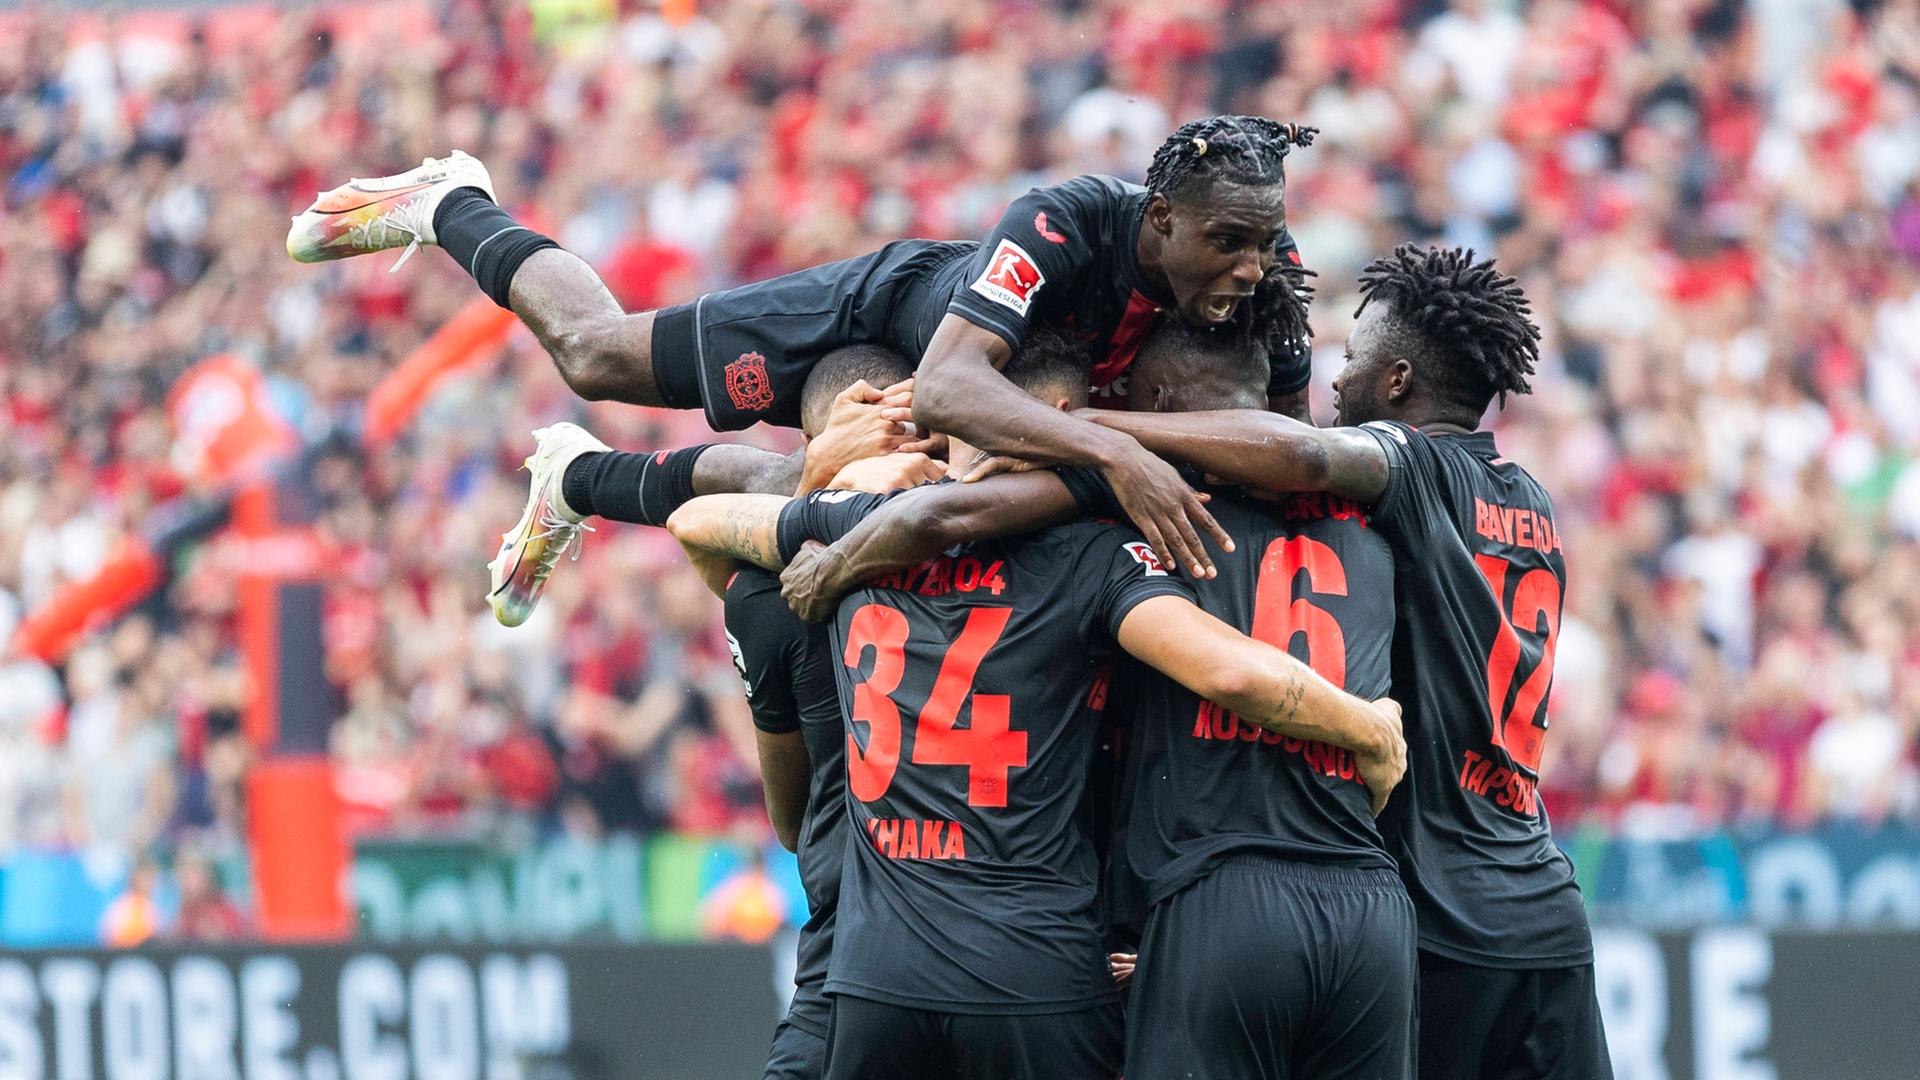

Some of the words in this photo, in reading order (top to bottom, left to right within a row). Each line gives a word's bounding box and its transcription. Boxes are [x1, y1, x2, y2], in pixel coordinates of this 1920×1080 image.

[844, 604, 1028, 808] 34
[1251, 535, 1348, 691] 6
[1474, 553, 1560, 773] 12
